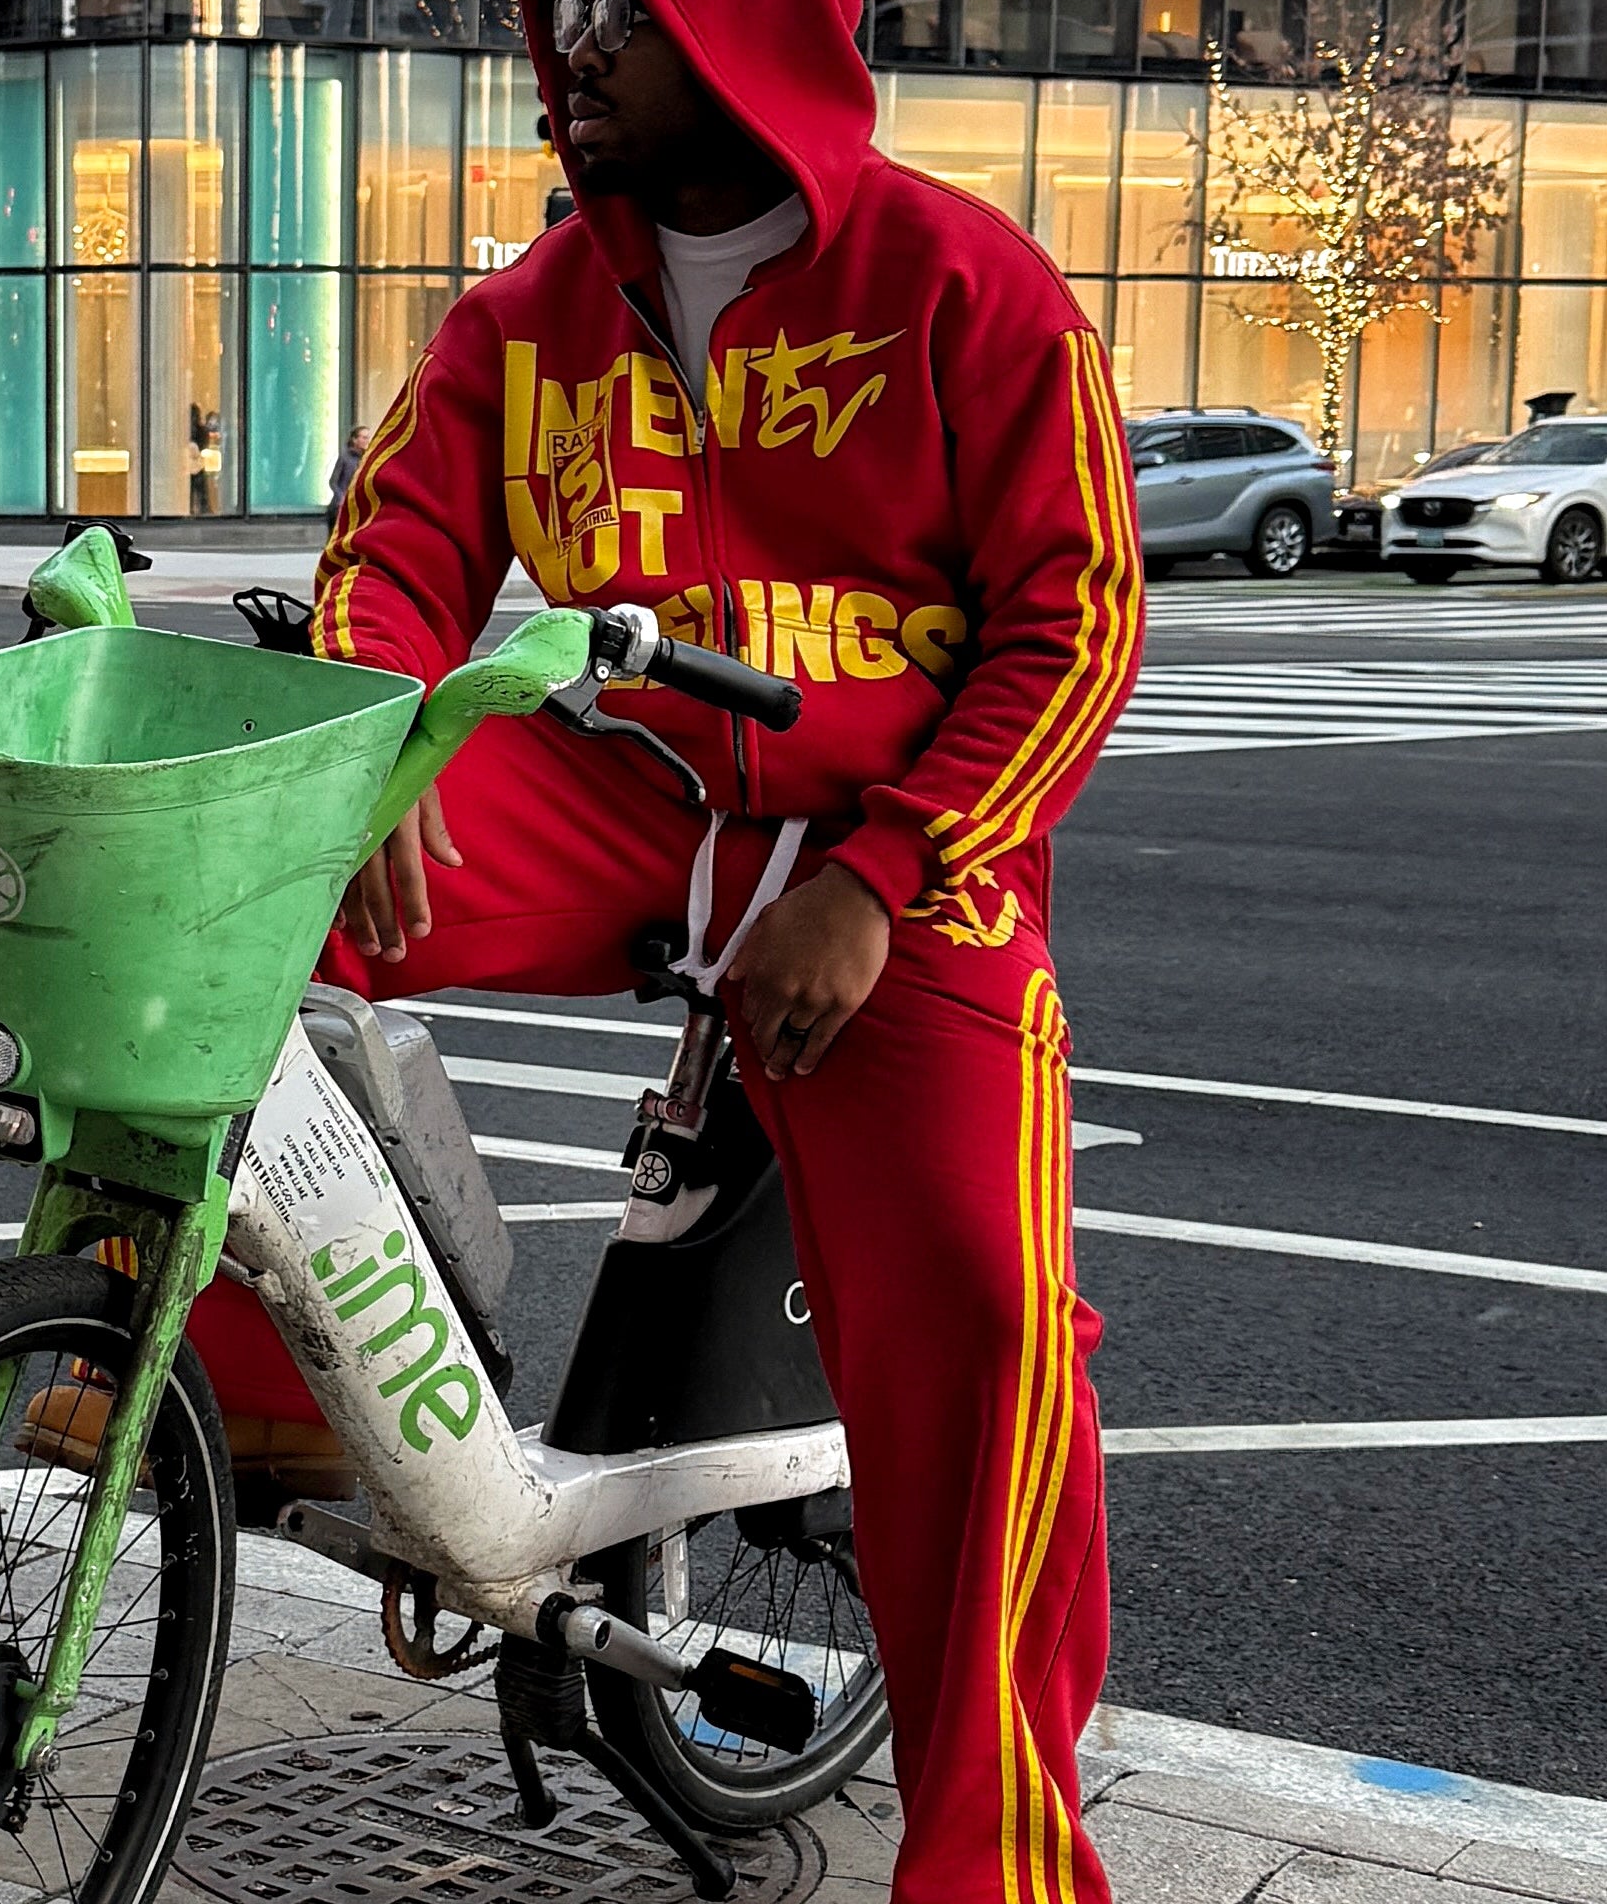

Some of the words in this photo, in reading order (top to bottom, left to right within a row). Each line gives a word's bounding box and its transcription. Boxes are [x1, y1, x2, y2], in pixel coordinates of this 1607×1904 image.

[504, 340, 772, 477] INTEN
[303, 1141, 319, 1164] CALL
[317, 1162, 328, 1176] 311
[322, 1118, 351, 1160] CONTACT
